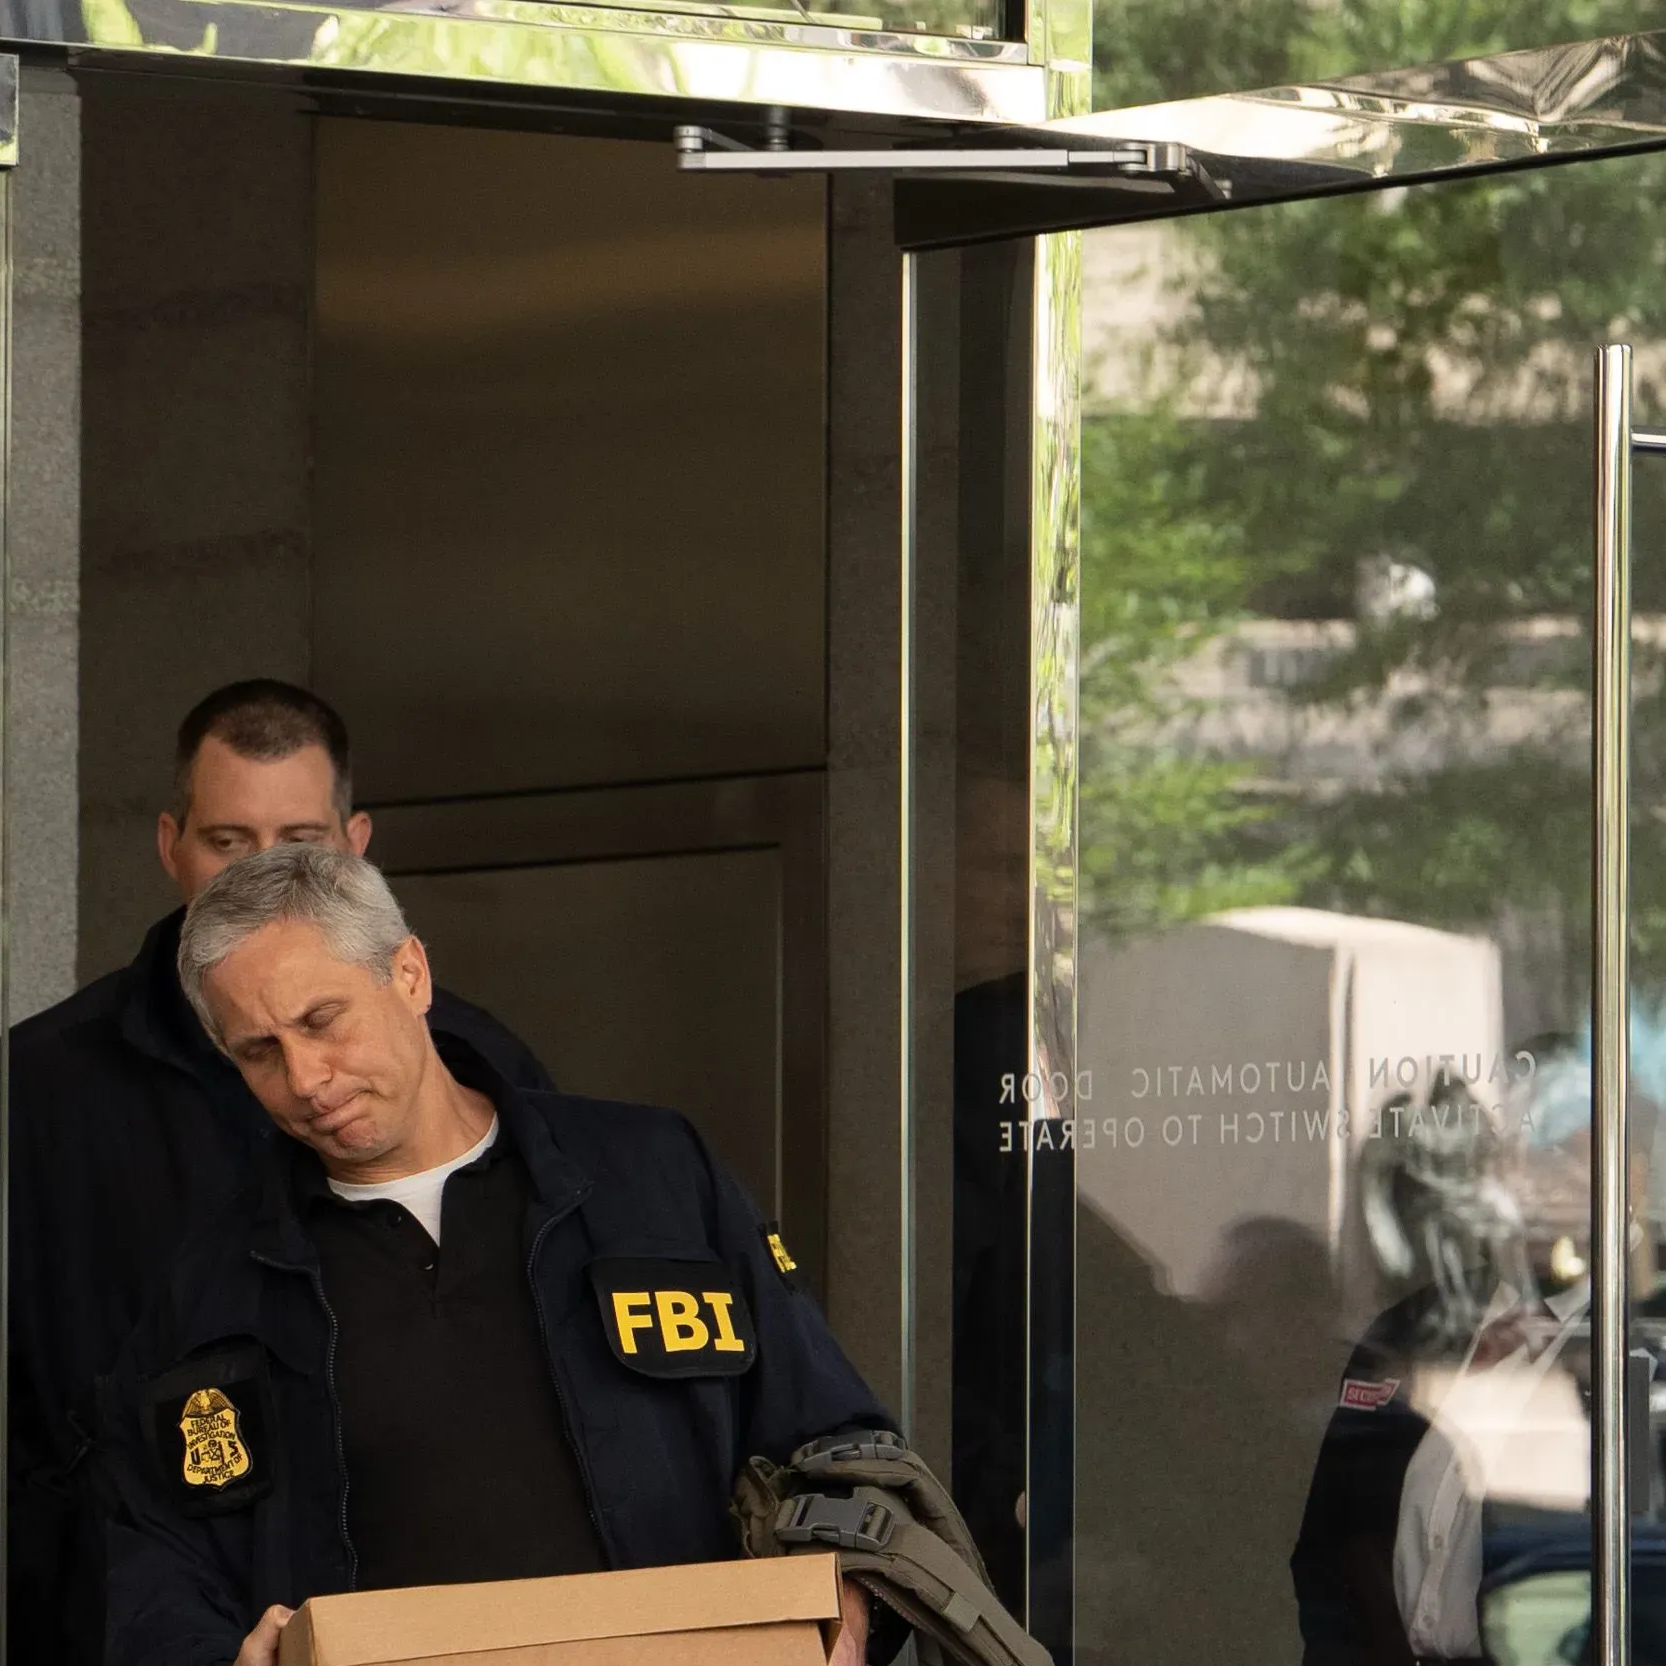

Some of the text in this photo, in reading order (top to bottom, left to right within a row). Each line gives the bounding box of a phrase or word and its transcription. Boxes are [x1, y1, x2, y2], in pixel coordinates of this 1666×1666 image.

[612, 1291, 744, 1354] FBI
[187, 1420, 232, 1437] BUREAU OF
[191, 1414, 227, 1428] FEDERAL
[188, 1431, 235, 1450] INVESTIGATION
[187, 1461, 233, 1476] DEPARTMENT
[204, 1470, 234, 1483] JUSTICE
